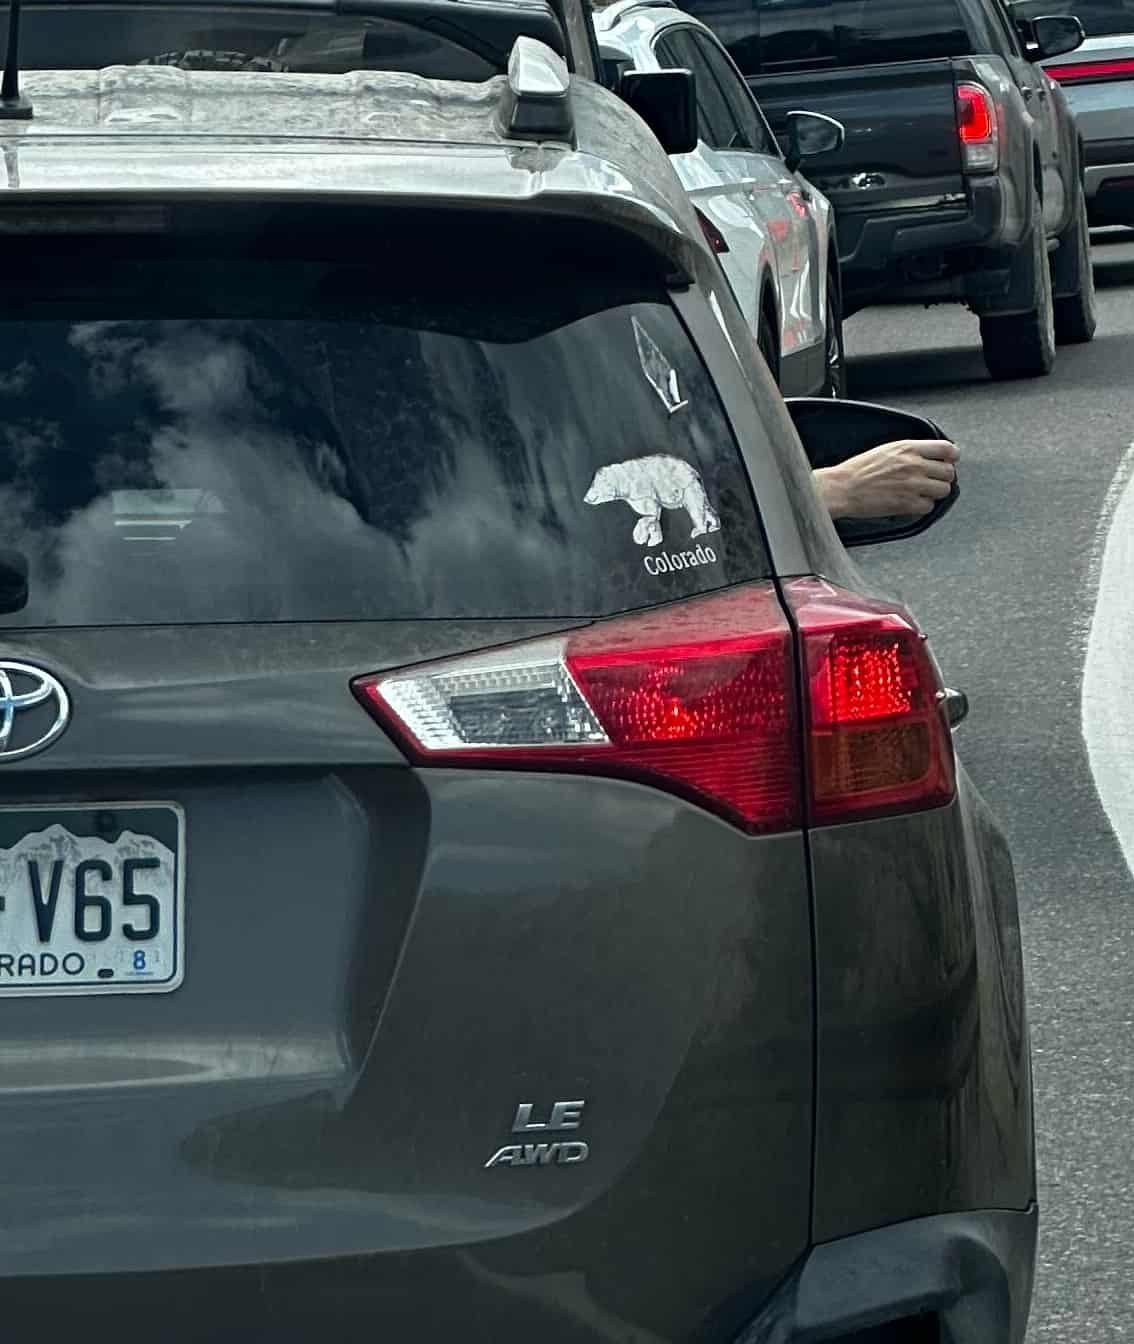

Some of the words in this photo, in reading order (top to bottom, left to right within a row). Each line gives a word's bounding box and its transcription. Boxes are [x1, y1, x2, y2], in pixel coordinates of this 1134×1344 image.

[643, 543, 718, 576] Colorado
[132, 949, 147, 970] 8
[511, 1100, 585, 1133] LE
[484, 1141, 590, 1168] AWD
